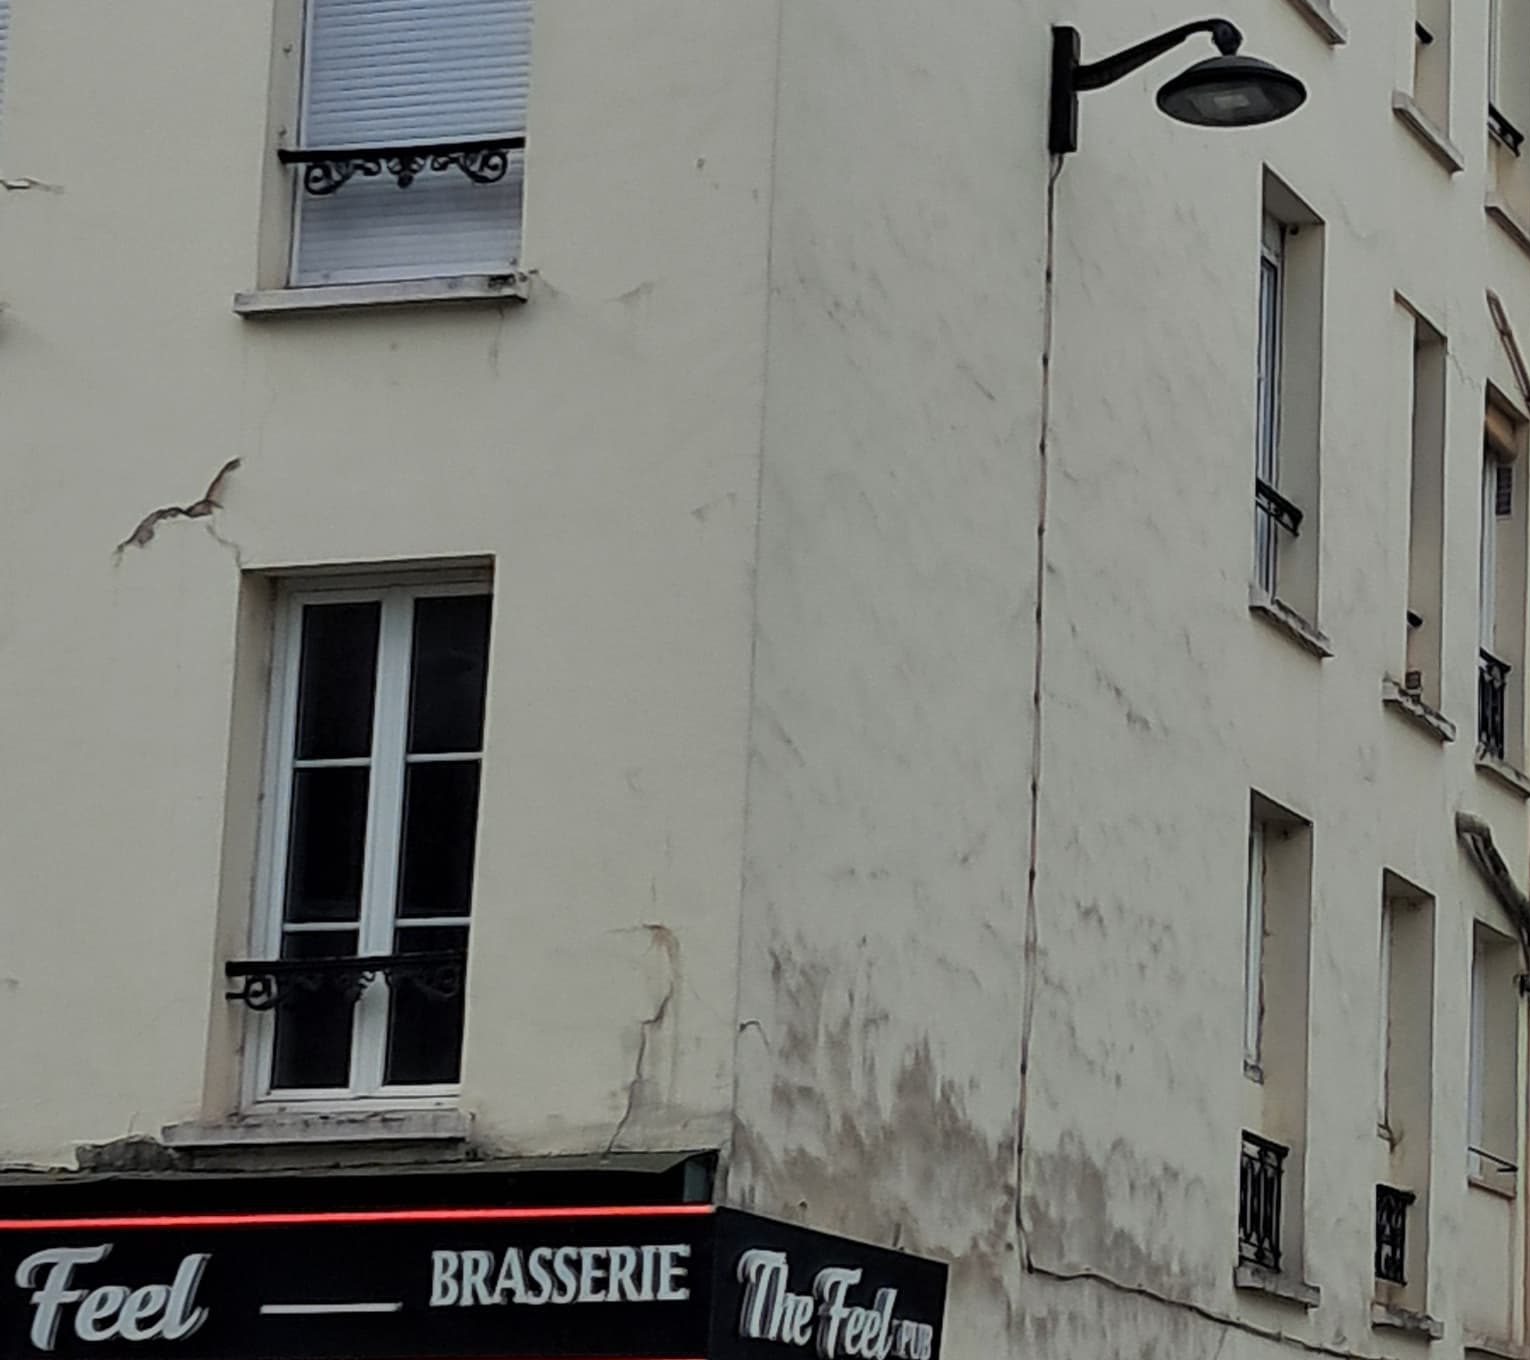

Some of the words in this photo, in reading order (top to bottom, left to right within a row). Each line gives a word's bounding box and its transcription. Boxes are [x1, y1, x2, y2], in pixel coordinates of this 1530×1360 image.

[15, 1243, 212, 1351] Feel
[429, 1243, 691, 1307] BRASSERIE
[737, 1248, 814, 1346] The
